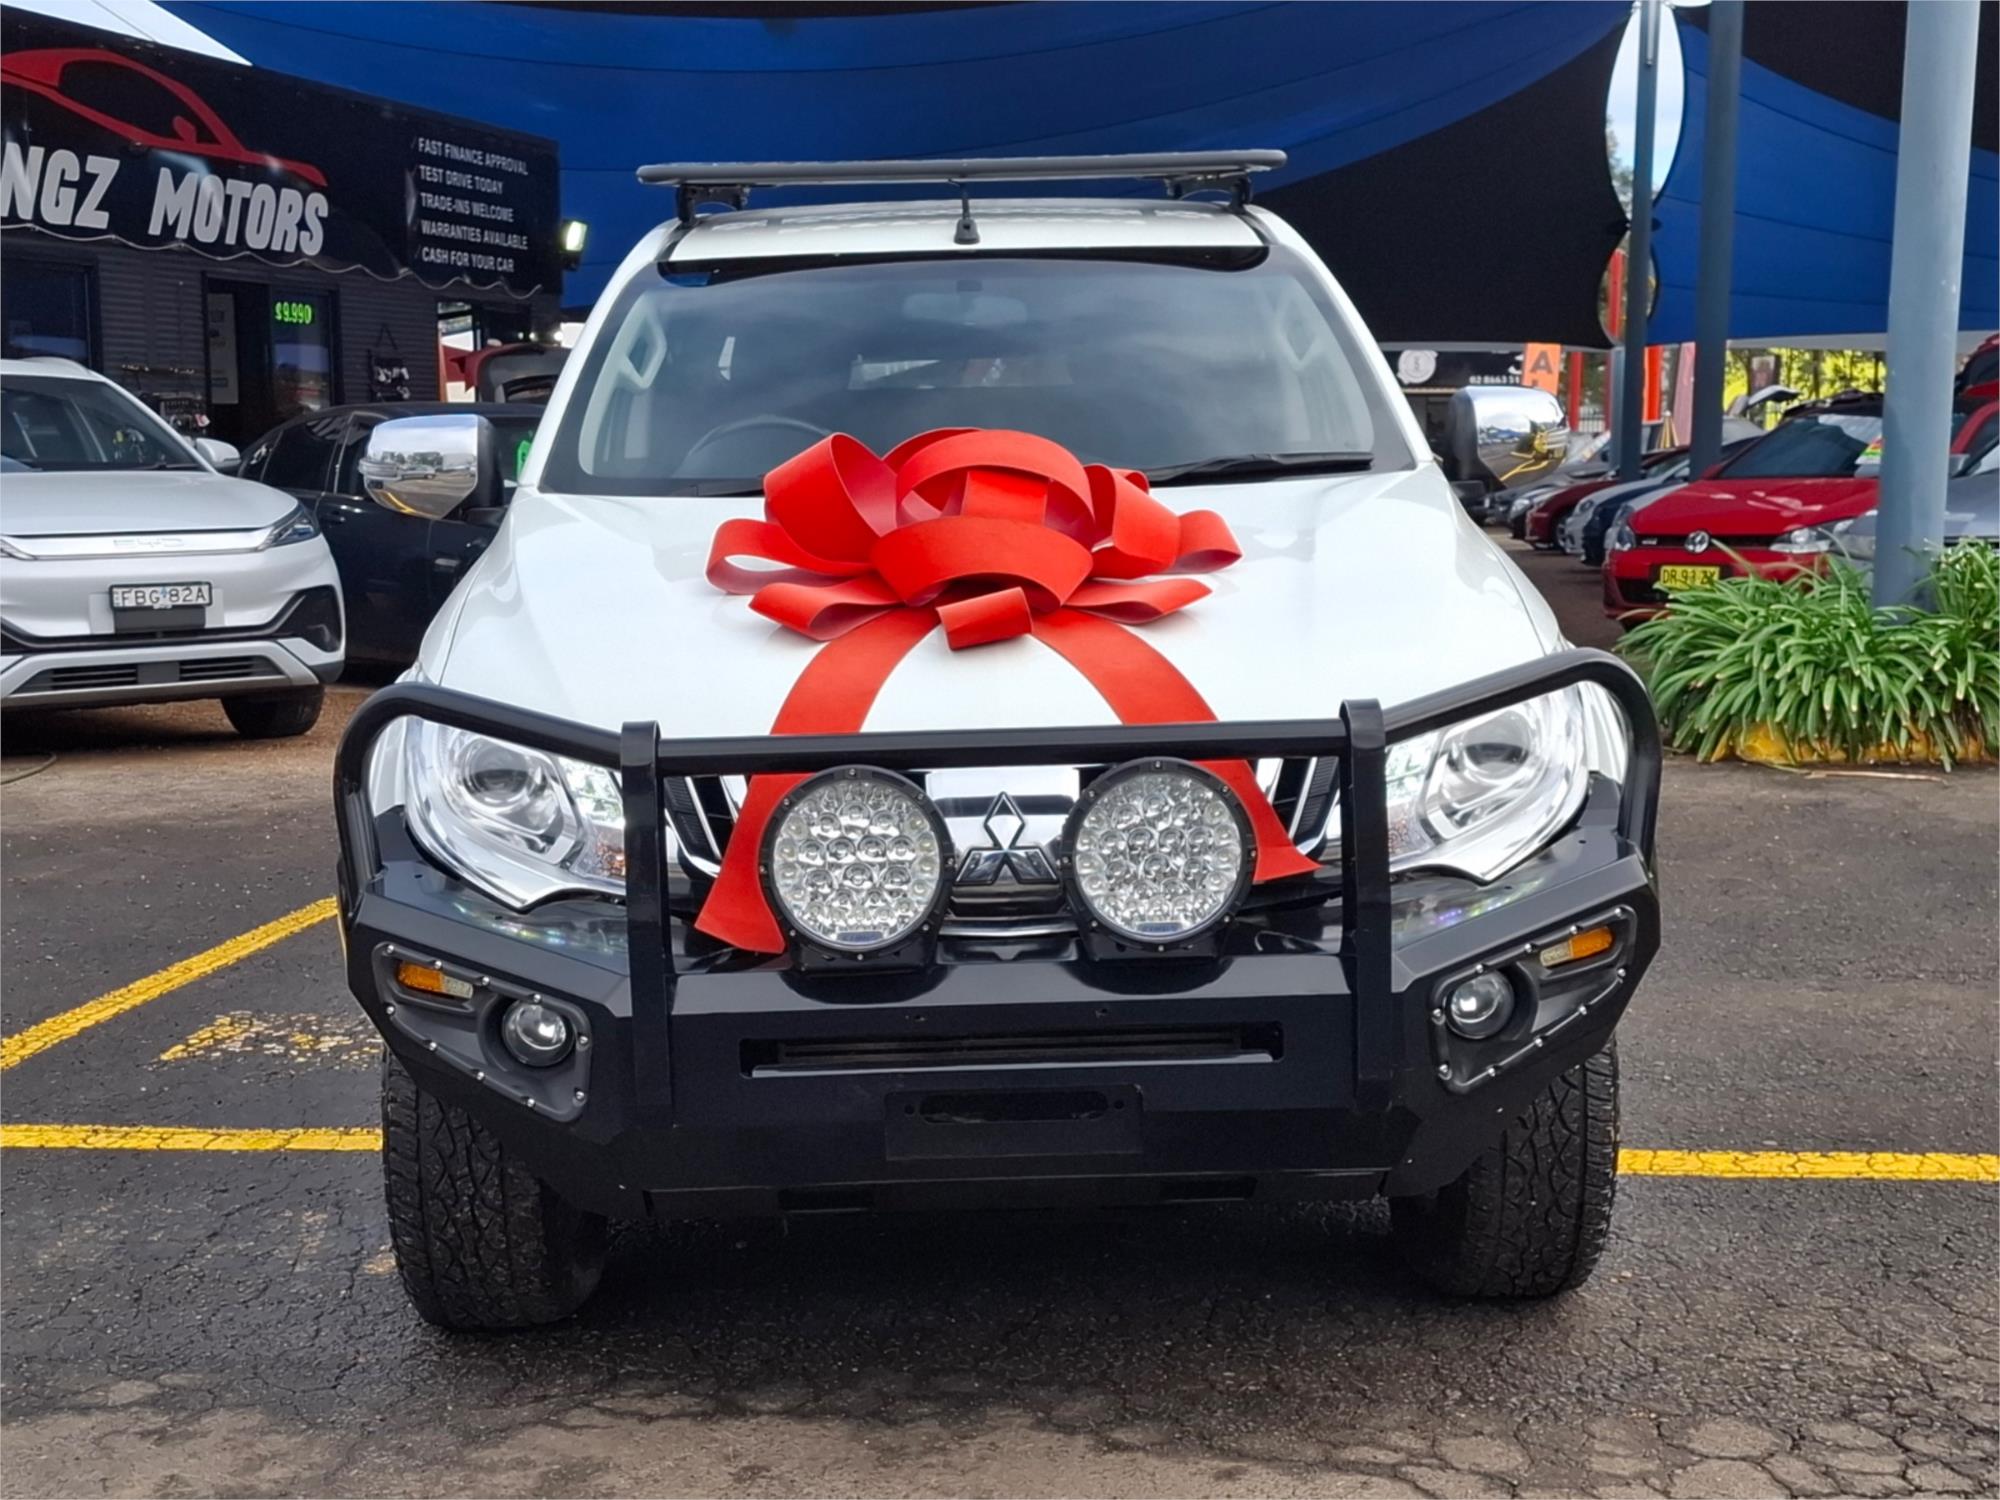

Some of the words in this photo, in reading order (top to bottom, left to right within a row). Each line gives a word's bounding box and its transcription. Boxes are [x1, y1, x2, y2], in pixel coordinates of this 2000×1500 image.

[418, 137, 442, 156] FAST
[444, 143, 484, 166] FINANCE
[485, 153, 529, 176] APPROVAL
[419, 165, 444, 183] TEST
[445, 170, 473, 189] DRIVE
[474, 176, 503, 194] TODAY
[147, 167, 329, 256] MOTORS
[420, 192, 470, 215] TRADE-INS
[471, 201, 515, 223] WELCOME
[420, 219, 481, 243] WARRANTIES
[483, 230, 529, 250] AVAILABLE
[422, 246, 449, 265] CASH
[451, 250, 470, 268] FOR
[471, 254, 495, 271] YOUR
[496, 257, 515, 273] CAR
